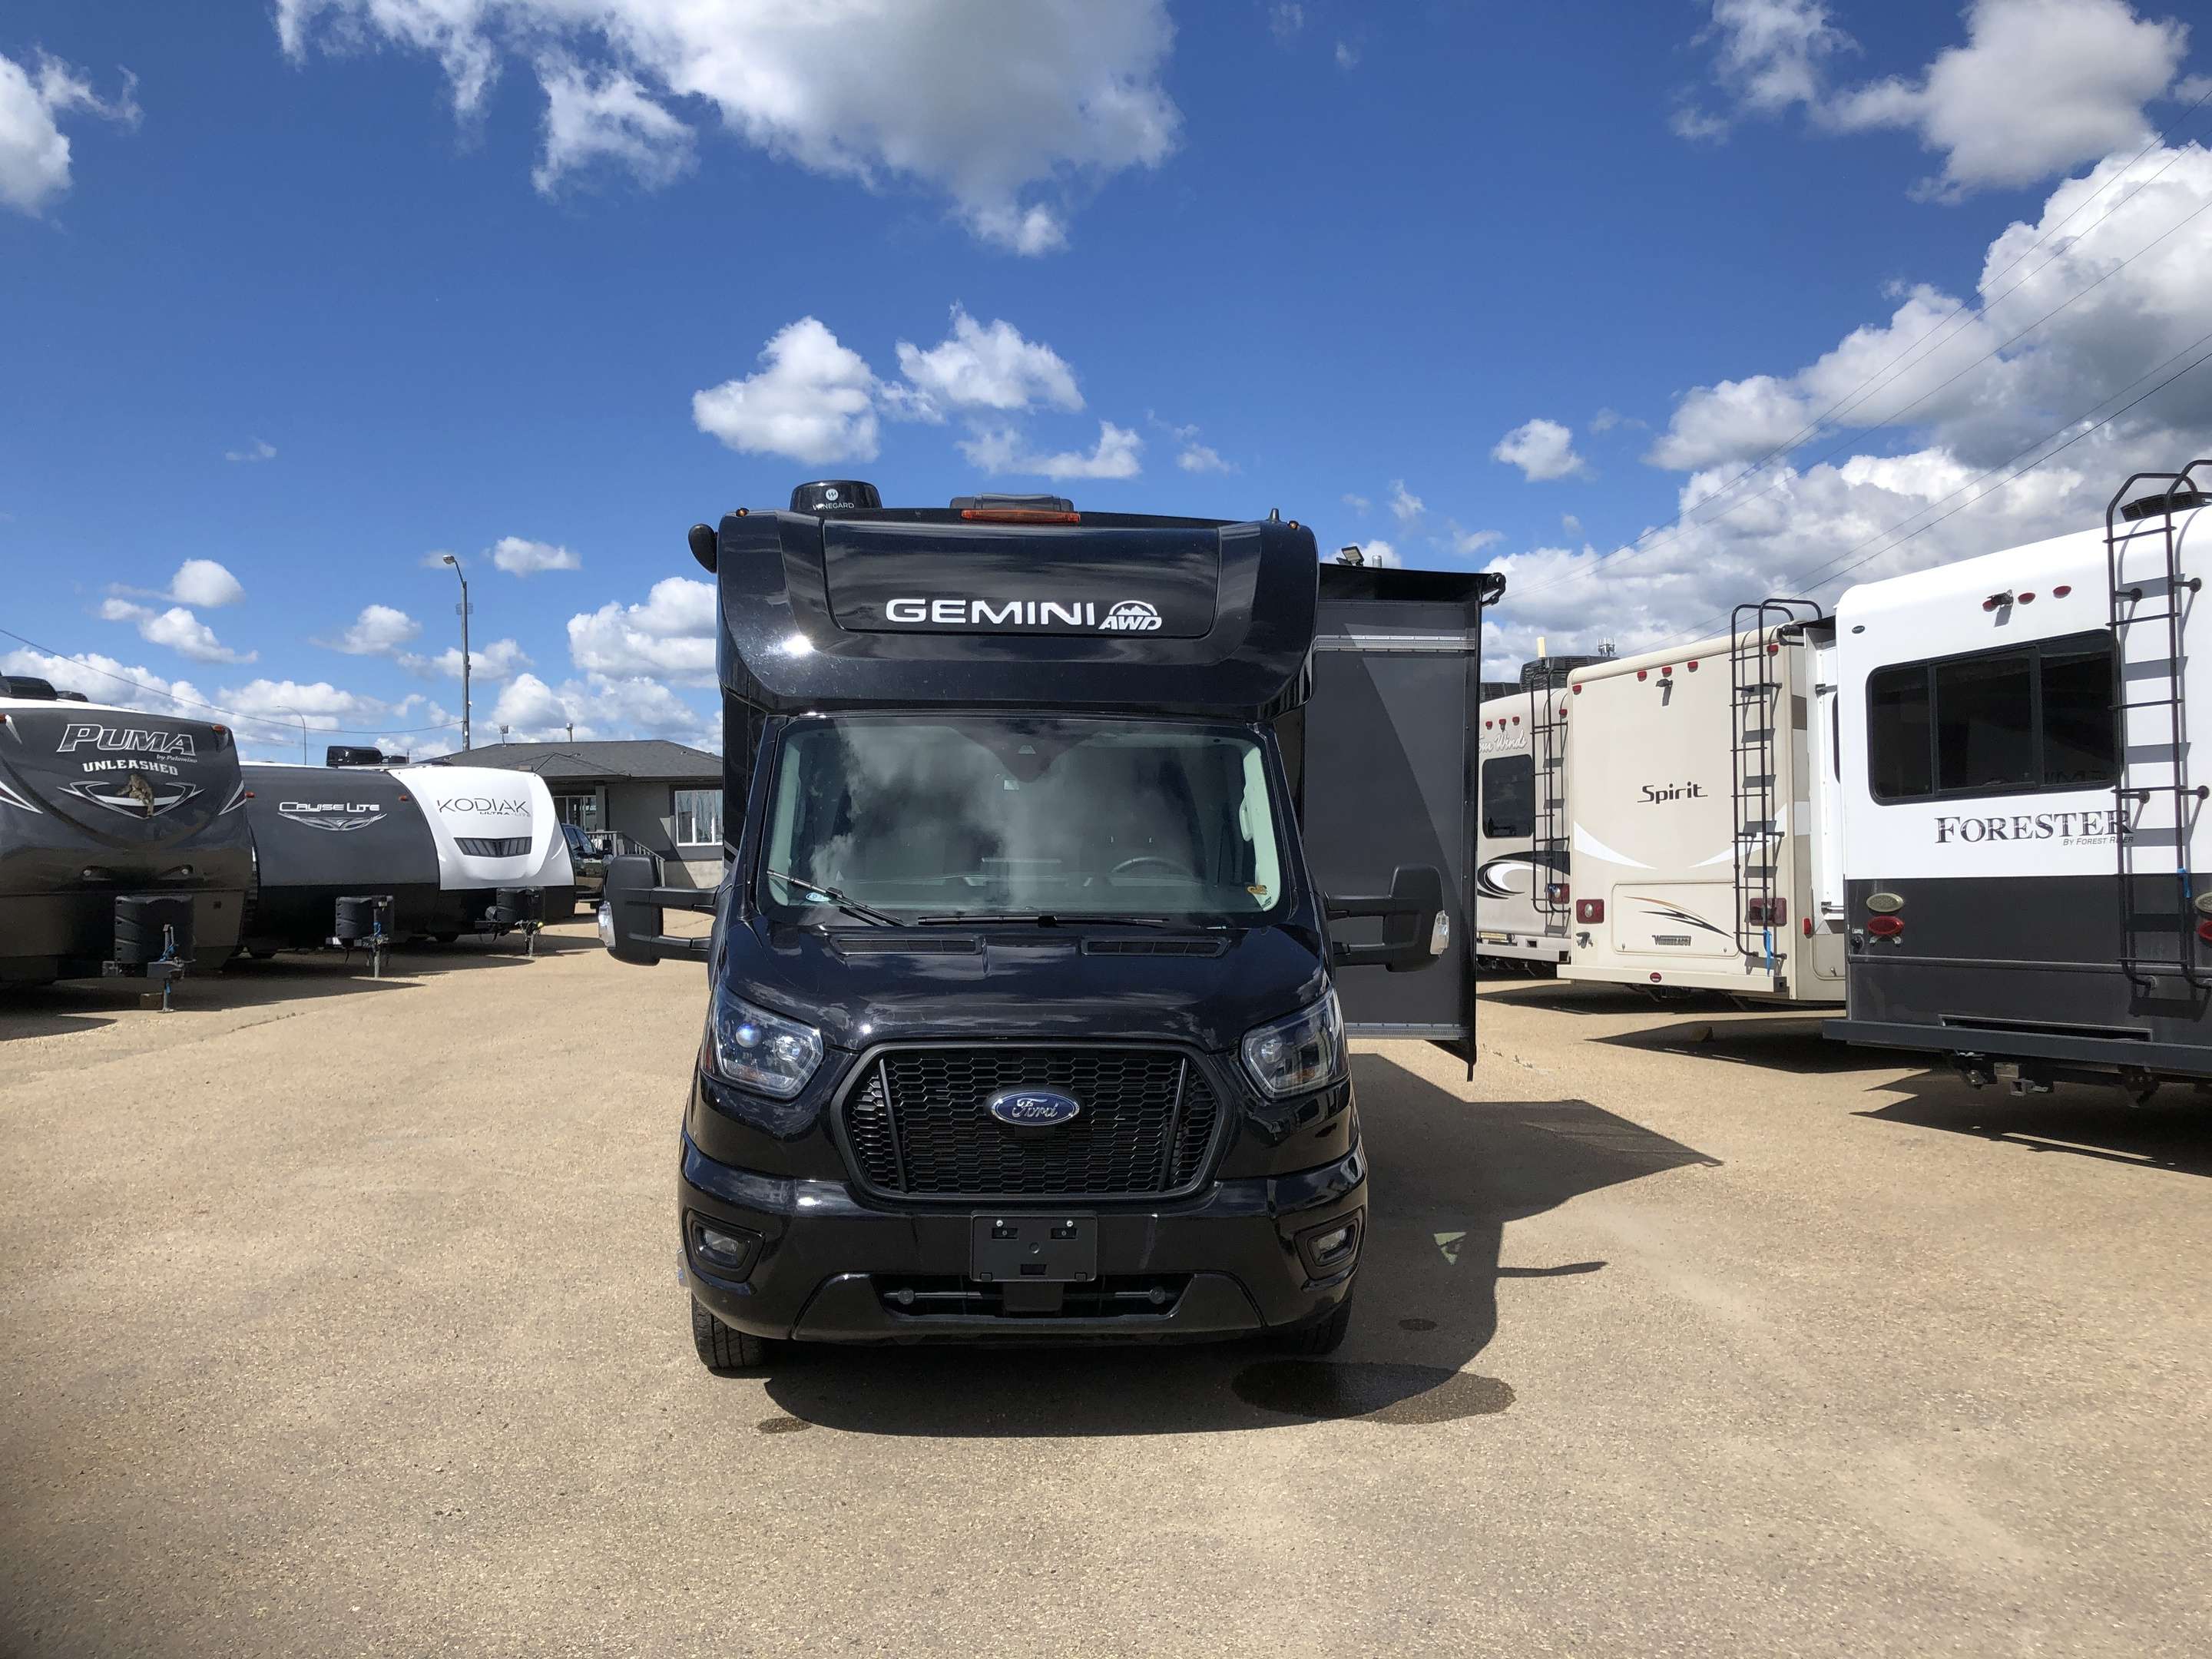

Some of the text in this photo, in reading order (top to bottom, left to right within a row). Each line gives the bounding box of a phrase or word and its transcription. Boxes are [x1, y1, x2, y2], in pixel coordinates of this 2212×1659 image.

[813, 502, 855, 511] WNEGARD
[885, 598, 1162, 631] GEMINI AWD
[56, 724, 197, 757] PUMA
[82, 760, 179, 776] UNLEASHED
[1637, 781, 1708, 804] Spirit
[436, 798, 529, 814] KODIAK
[1934, 810, 2134, 843] FORESTER
[2076, 837, 2108, 846] FOREST
[1012, 1098, 1059, 1118] Ford
